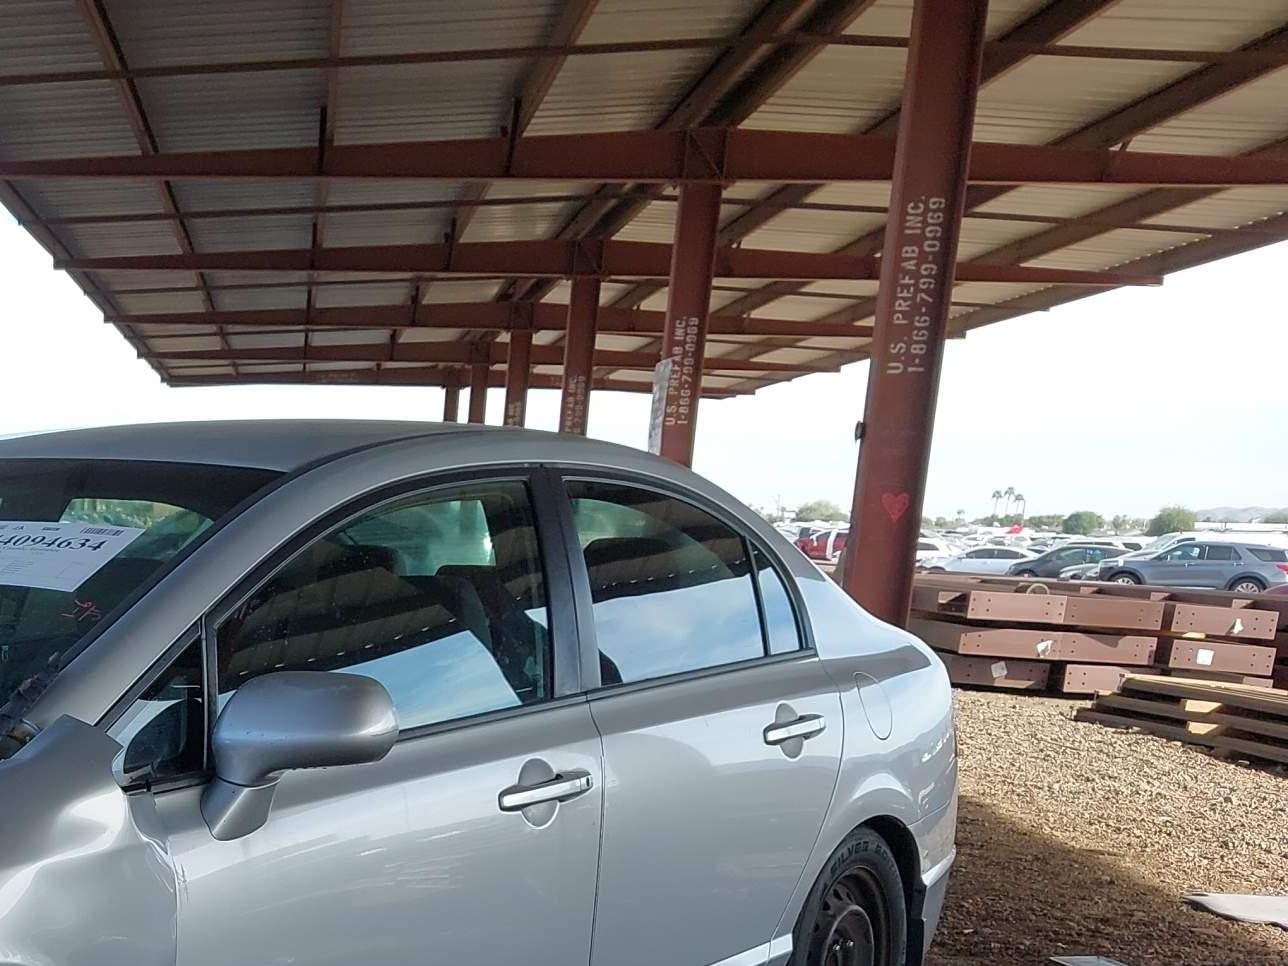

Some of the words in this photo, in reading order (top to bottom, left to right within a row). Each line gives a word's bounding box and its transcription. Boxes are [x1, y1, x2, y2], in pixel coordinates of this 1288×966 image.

[904, 195, 926, 235] INC.
[893, 245, 919, 324] PREFAB
[907, 197, 946, 373] 1-866-799-0969
[674, 316, 687, 340] INC.
[668, 346, 684, 395] PREFAB
[887, 335, 908, 375] U.S.
[665, 401, 678, 425] U.S.
